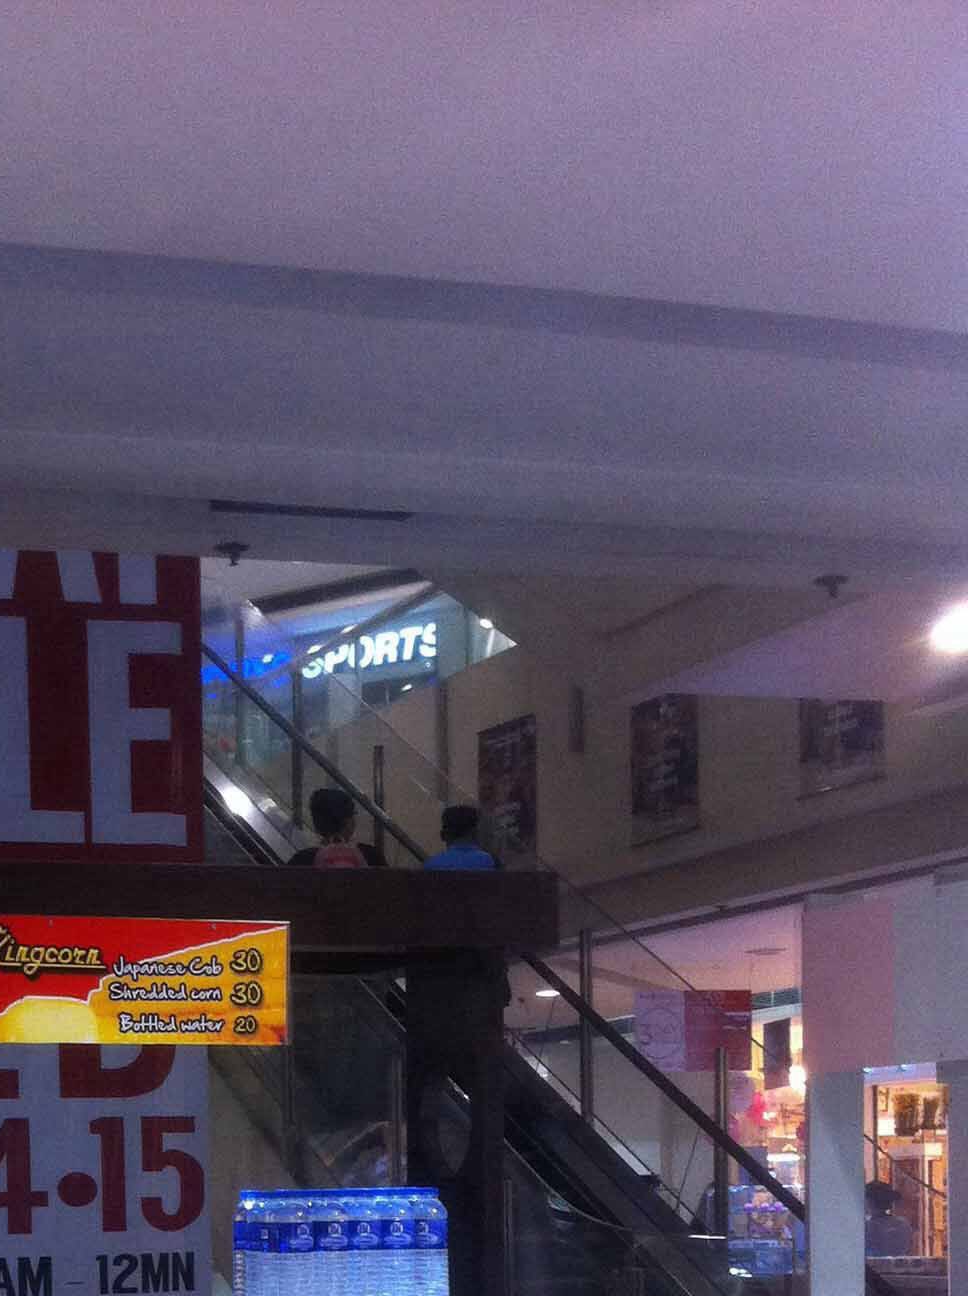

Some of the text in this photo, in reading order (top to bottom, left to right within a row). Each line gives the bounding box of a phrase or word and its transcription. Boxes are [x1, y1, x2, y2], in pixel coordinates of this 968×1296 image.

[302, 622, 437, 679] SPORTS
[112, 949, 261, 981] Japanese Cob 30
[108, 981, 261, 1007] Shredded corn 30
[118, 1013, 256, 1033] Bottled water 20
[95, 1251, 195, 1295] 12MN
